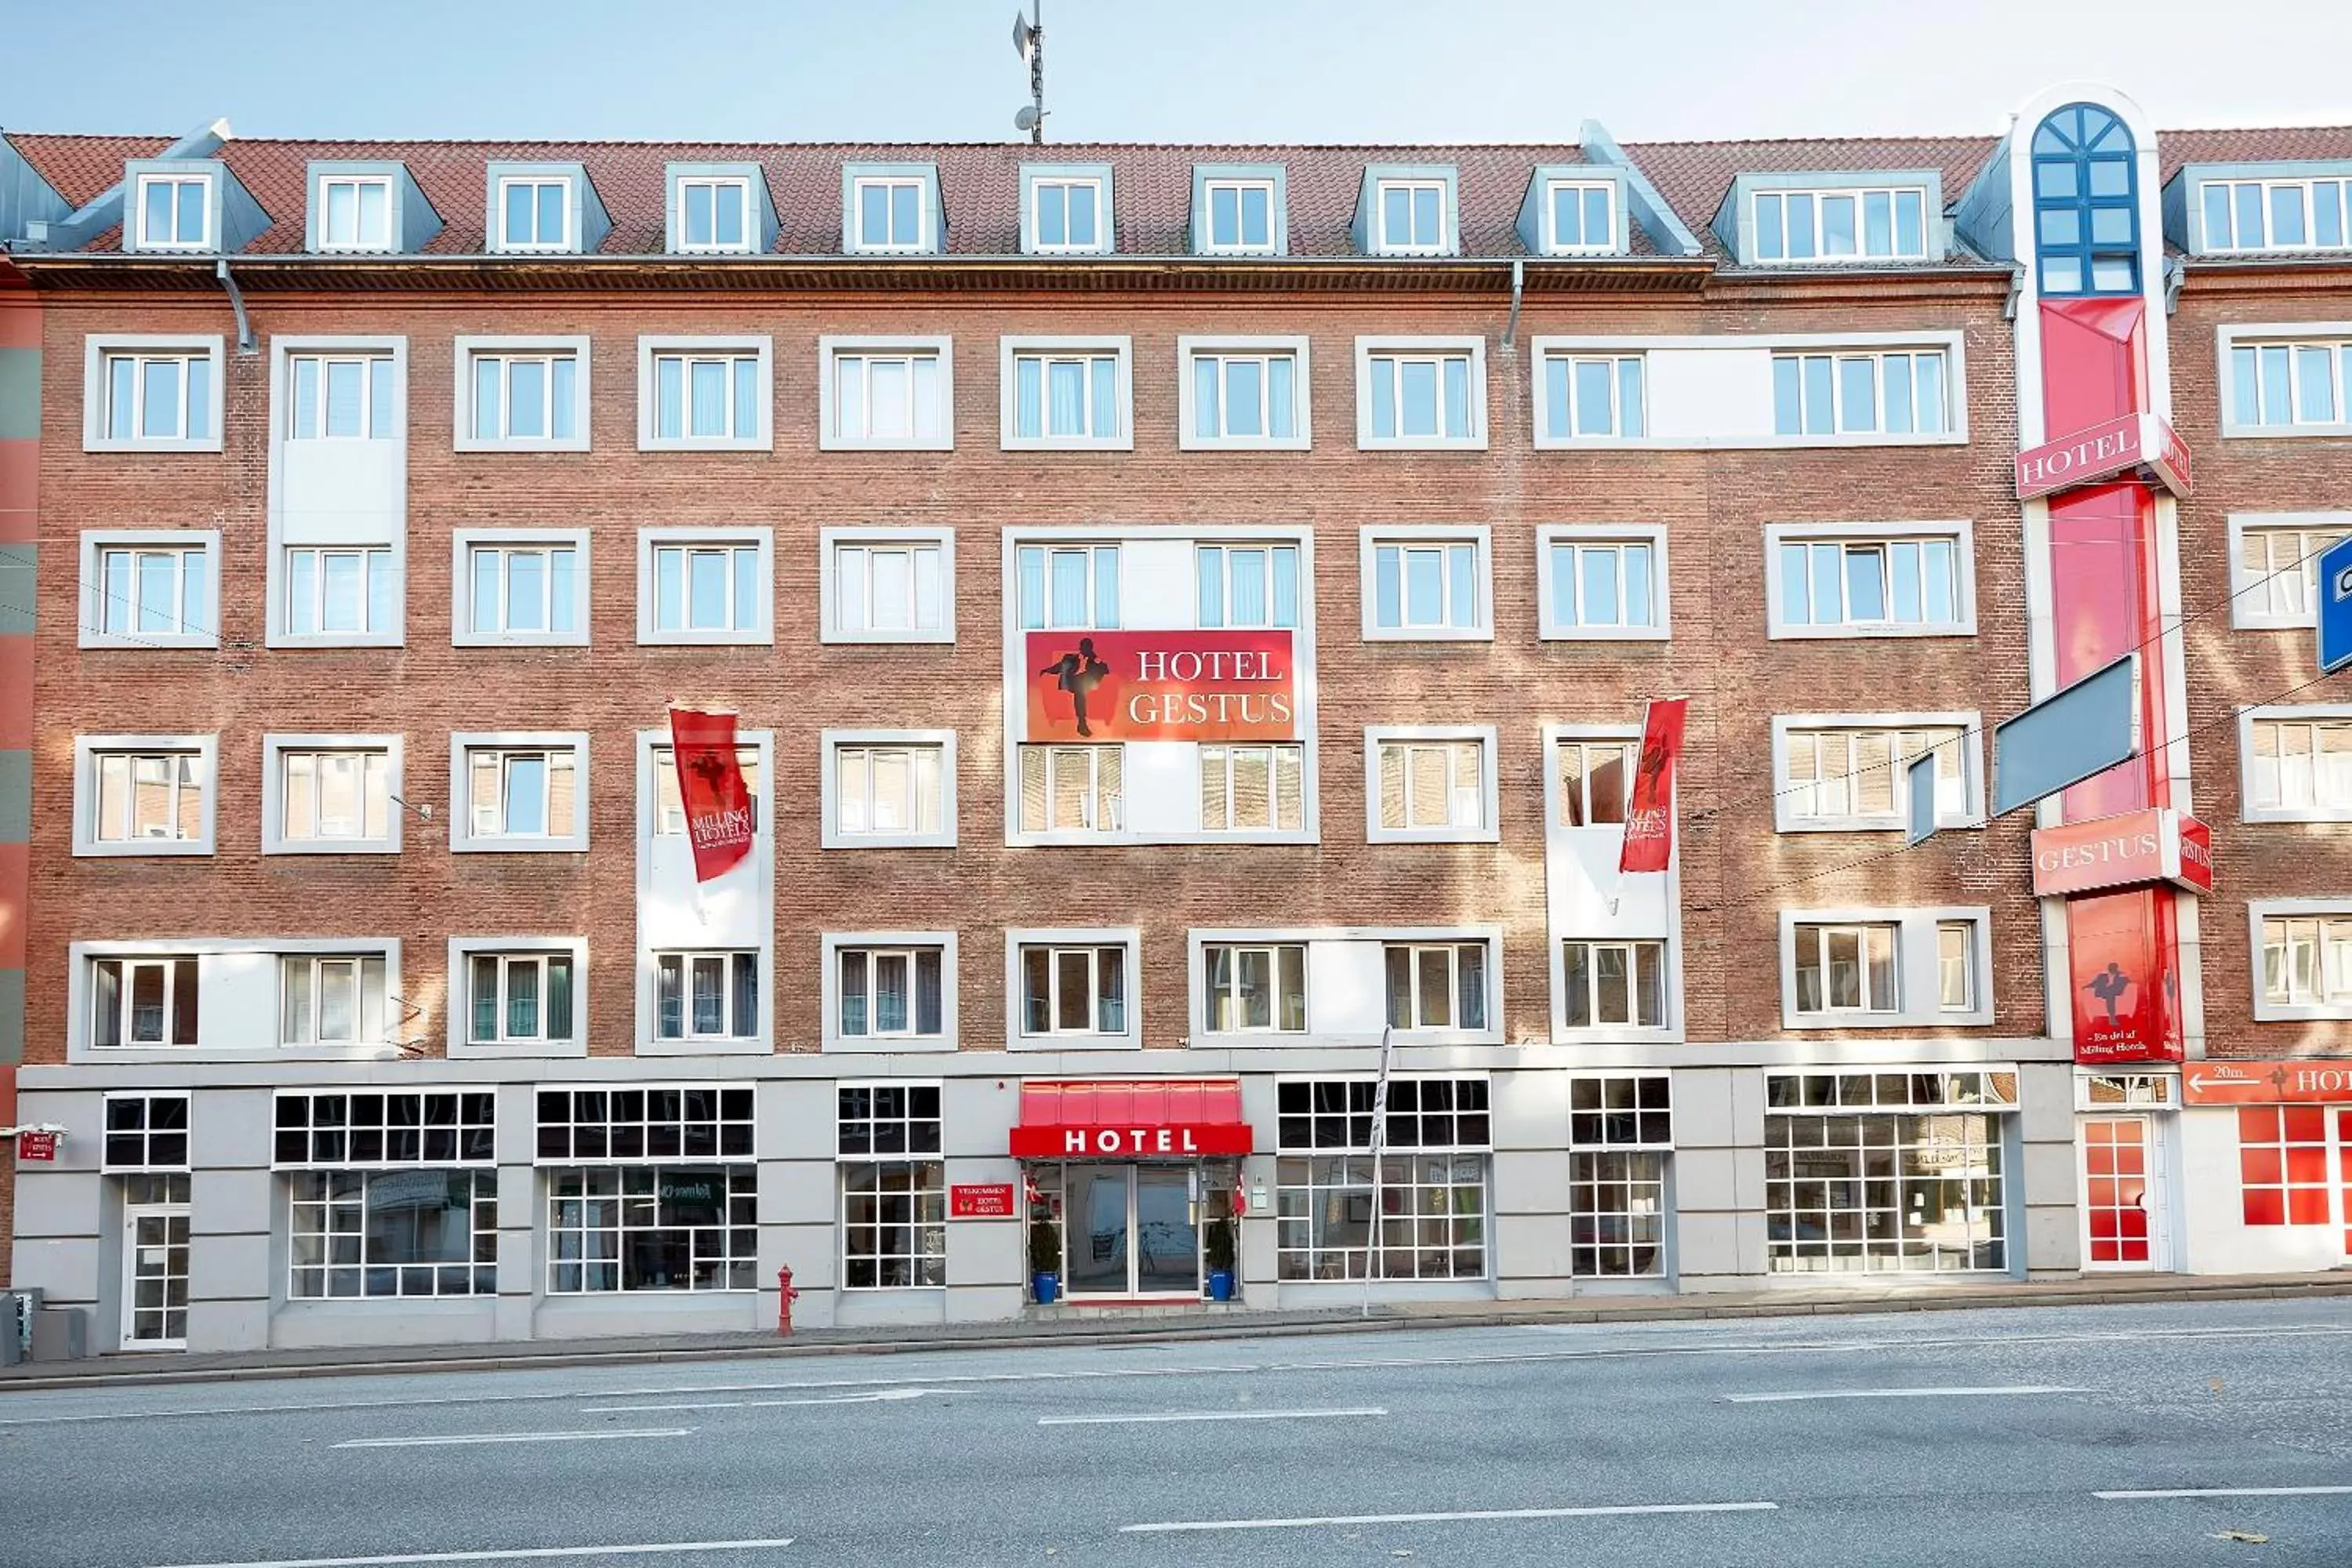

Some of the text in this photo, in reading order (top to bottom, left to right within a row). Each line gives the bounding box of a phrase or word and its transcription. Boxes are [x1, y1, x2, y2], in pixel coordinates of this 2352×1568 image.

[2021, 429, 2138, 484] HOTEL
[1136, 652, 1283, 681] HOTEL
[1128, 693, 1291, 724] GESTUS
[691, 806, 750, 831] MILLING
[694, 825, 751, 844] HOTELS
[2038, 833, 2158, 872] GESTUS
[2181, 836, 2211, 868] GESTUS
[1065, 1128, 1199, 1152] HOTEL
